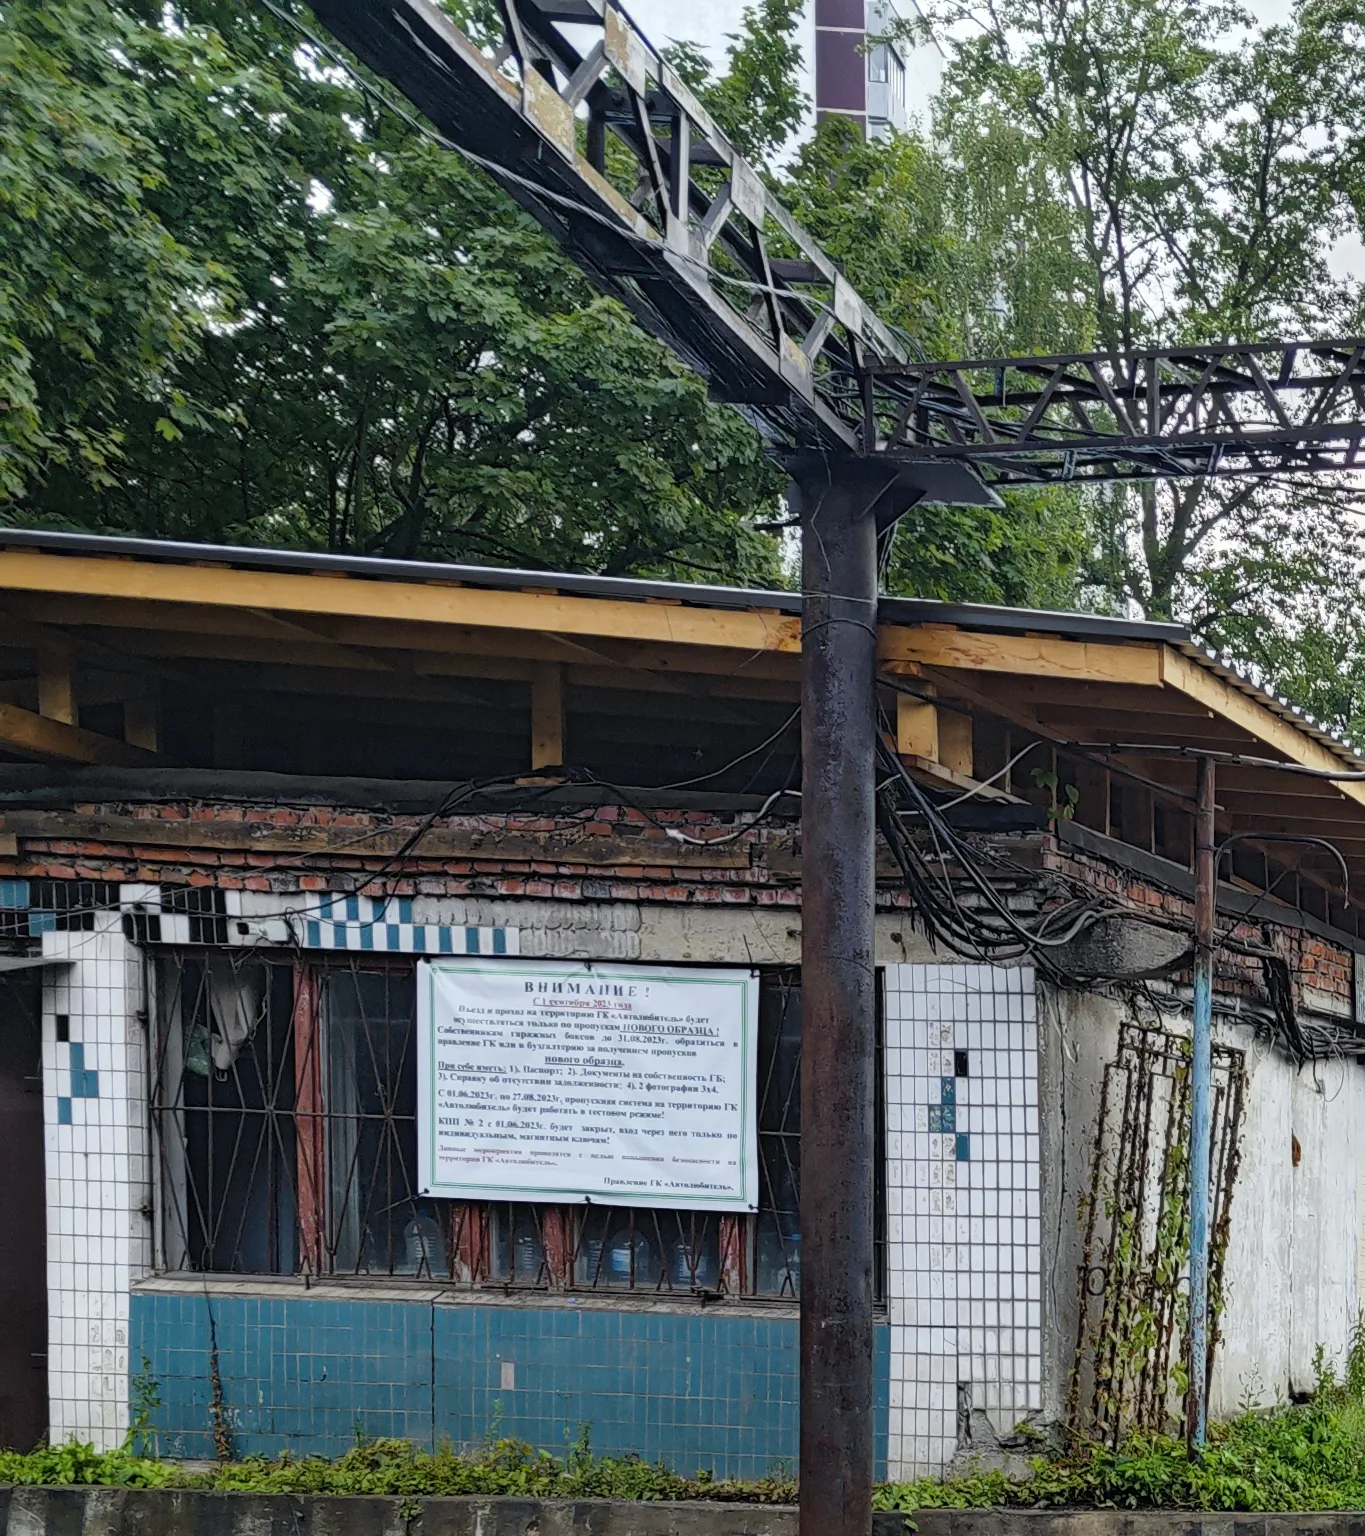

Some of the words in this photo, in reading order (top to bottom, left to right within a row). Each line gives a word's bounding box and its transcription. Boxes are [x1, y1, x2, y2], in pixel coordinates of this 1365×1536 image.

[540, 1010, 594, 1020] территорию
[596, 1011, 609, 1019] ГК
[685, 1015, 710, 1025] будет
[527, 1020, 559, 1028] только
[574, 1022, 620, 1032] пропускам
[623, 1023, 665, 1033] НОВОГО
[510, 1031, 556, 1041] гаражных
[564, 1032, 595, 1041] боксов
[437, 1038, 481, 1048] правление
[483, 1040, 496, 1048] ГК
[527, 1043, 584, 1053] бухгалтерию
[544, 1056, 580, 1064] нового
[438, 1061, 455, 1071] При
[457, 1063, 474, 1071] себе
[579, 1068, 630, 1079] Документы
[450, 1075, 486, 1086] Справку
[489, 1075, 500, 1083] об
[645, 1083, 699, 1094] фотографии
[512, 1104, 537, 1114] будет
[540, 1106, 578, 1116] работать
[618, 1100, 652, 1108] система
[668, 1102, 722, 1112] территорию
[724, 1103, 738, 1112] ГК
[438, 1116, 459, 1126] КПП
[464, 1118, 475, 1127] №
[478, 1119, 484, 1127] 2
[550, 1123, 573, 1134] будет
[619, 1128, 638, 1136] вход
[690, 1131, 723, 1139] только
[482, 1156, 494, 1164] ГК
[650, 1179, 663, 1187] ГК
